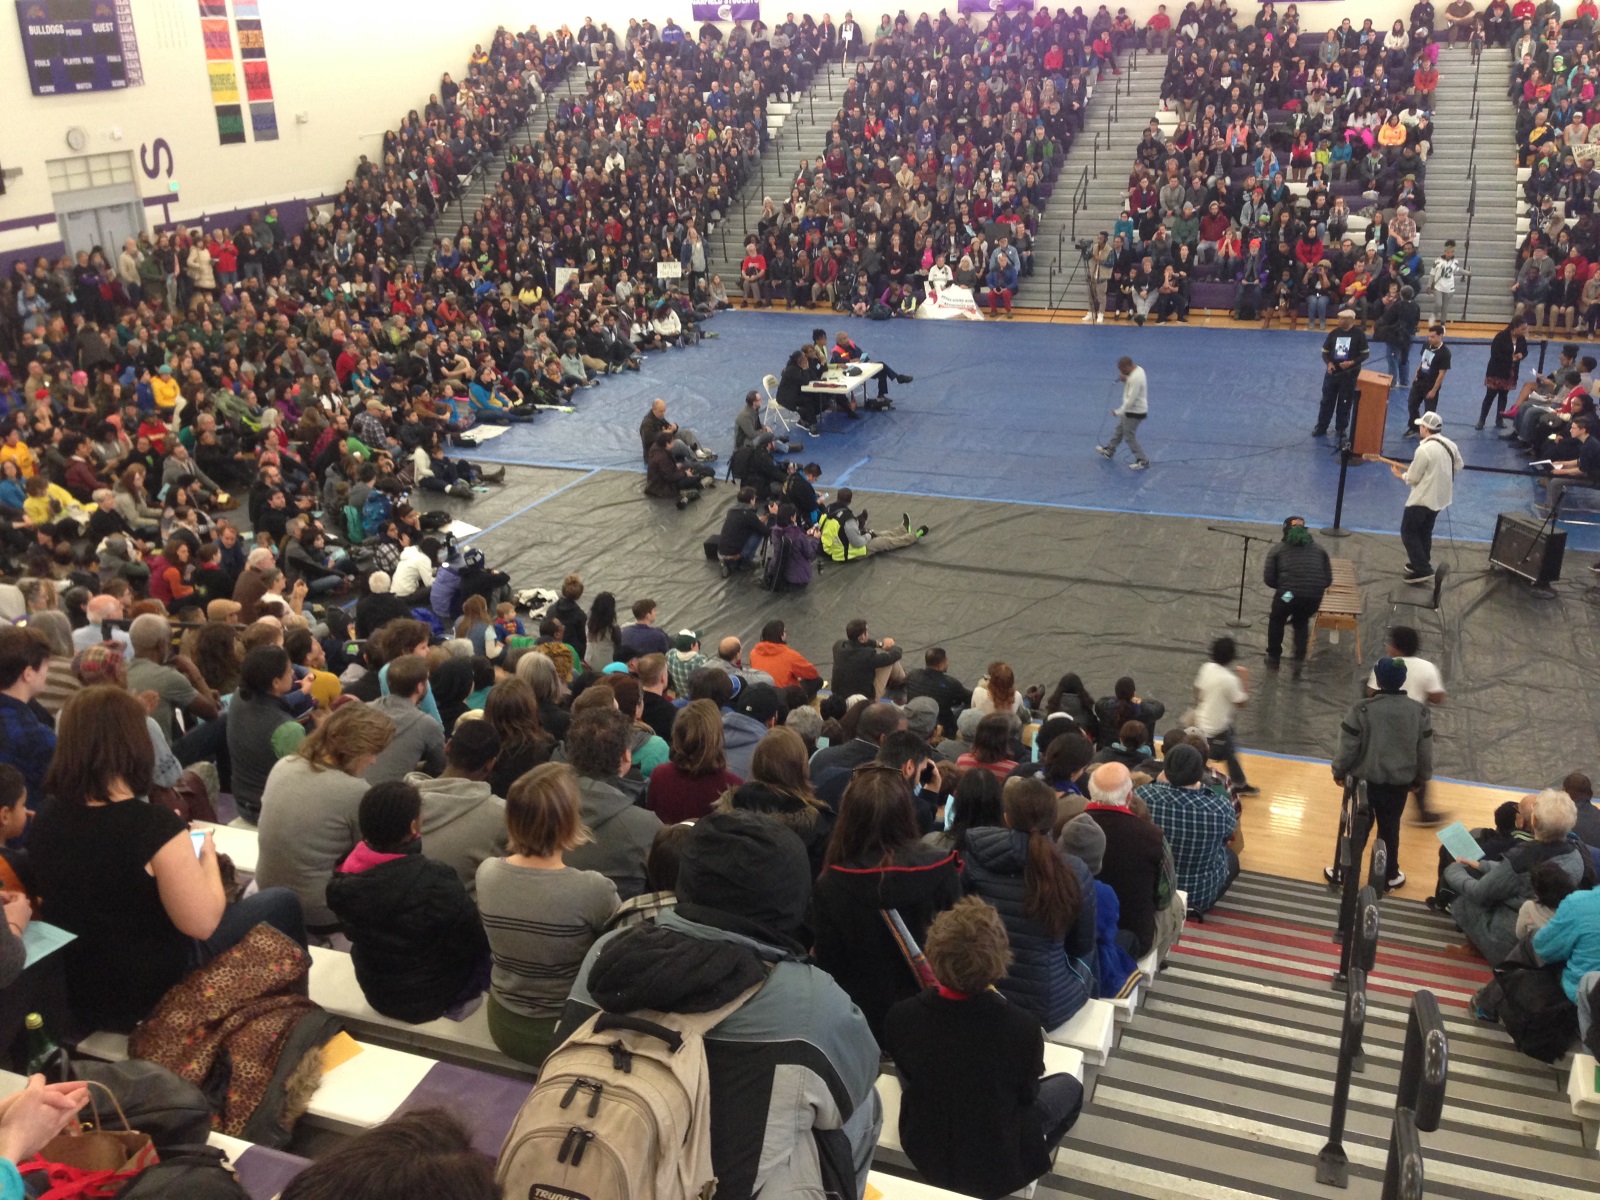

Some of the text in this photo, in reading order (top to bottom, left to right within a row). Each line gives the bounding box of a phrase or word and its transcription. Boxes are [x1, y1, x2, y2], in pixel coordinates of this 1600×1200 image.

[28, 24, 65, 35] BULLDOGS
[65, 28, 83, 37] PERIOD
[92, 22, 114, 33] GUEST
